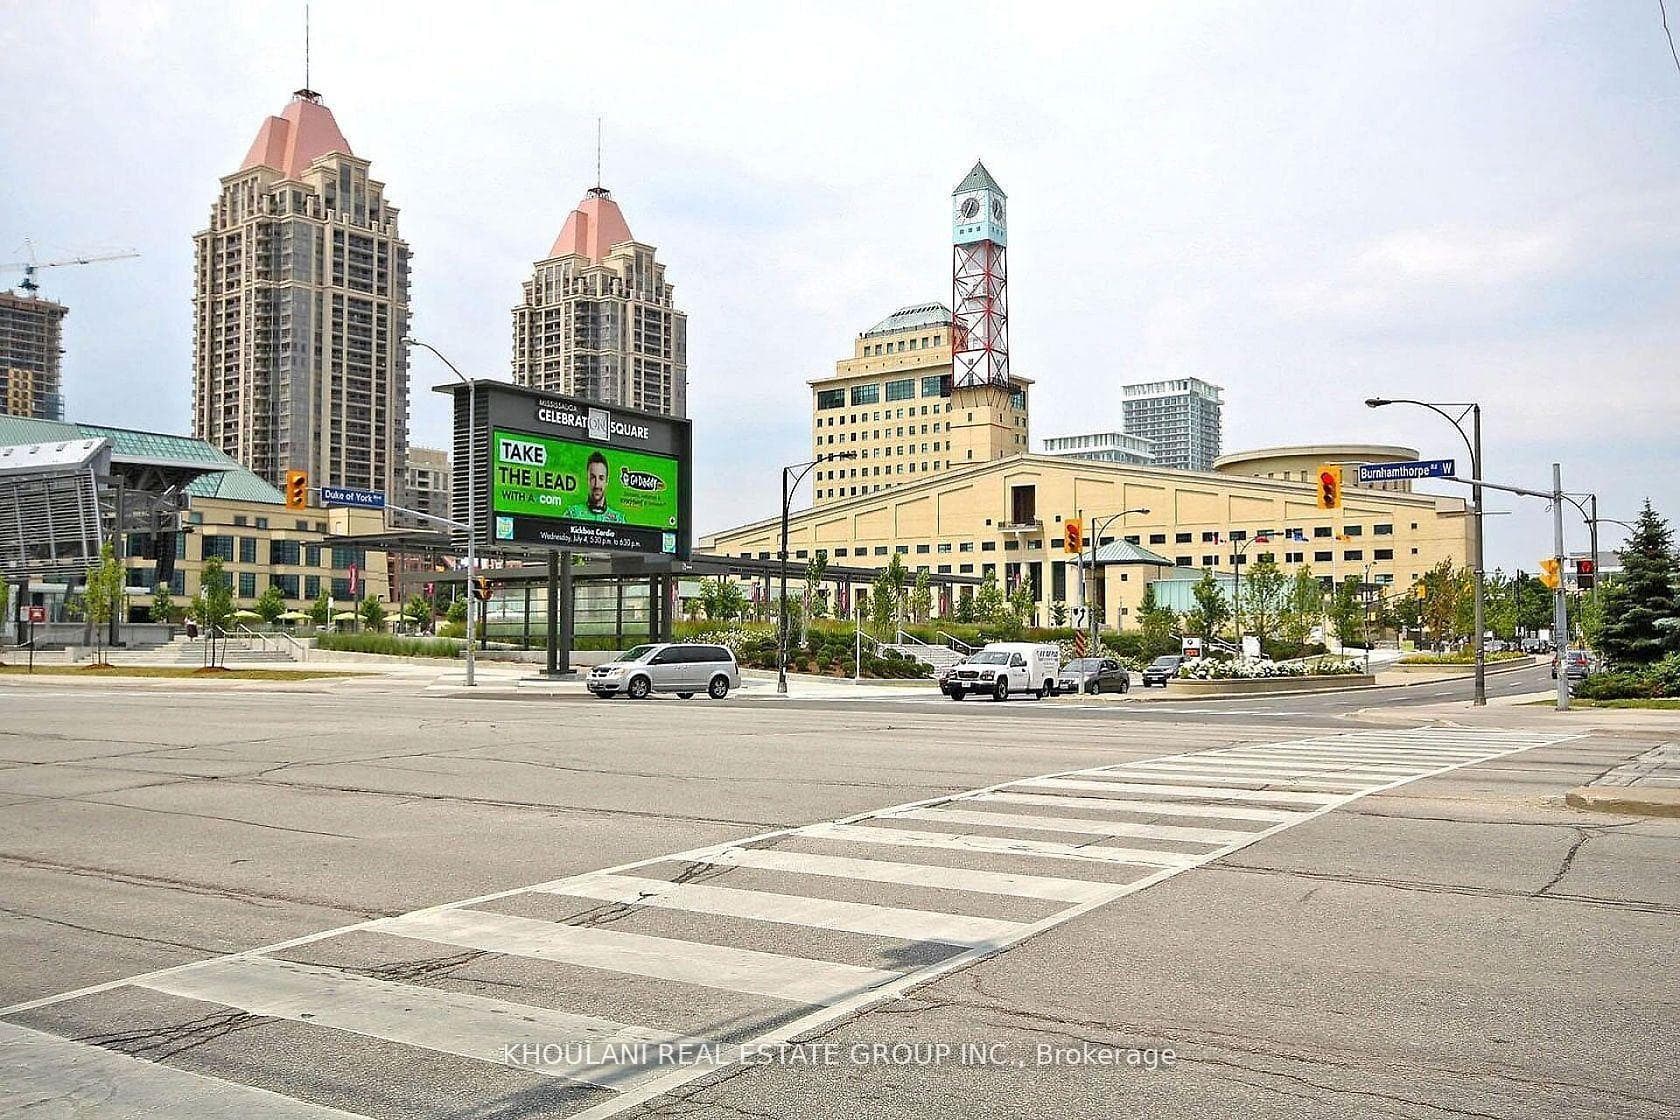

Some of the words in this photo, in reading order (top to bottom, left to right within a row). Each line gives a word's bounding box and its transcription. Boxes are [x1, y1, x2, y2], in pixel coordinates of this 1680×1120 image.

[610, 421, 649, 439] SQUARE
[502, 442, 543, 463] TAKE
[499, 467, 531, 486] THE
[536, 470, 577, 491] LEAD
[1361, 465, 1430, 479] Burnhamthorpe
[1442, 461, 1452, 474] W
[325, 489, 344, 499] Duke
[345, 492, 353, 500] of
[355, 492, 372, 502] York
[502, 490, 525, 502] WITH
